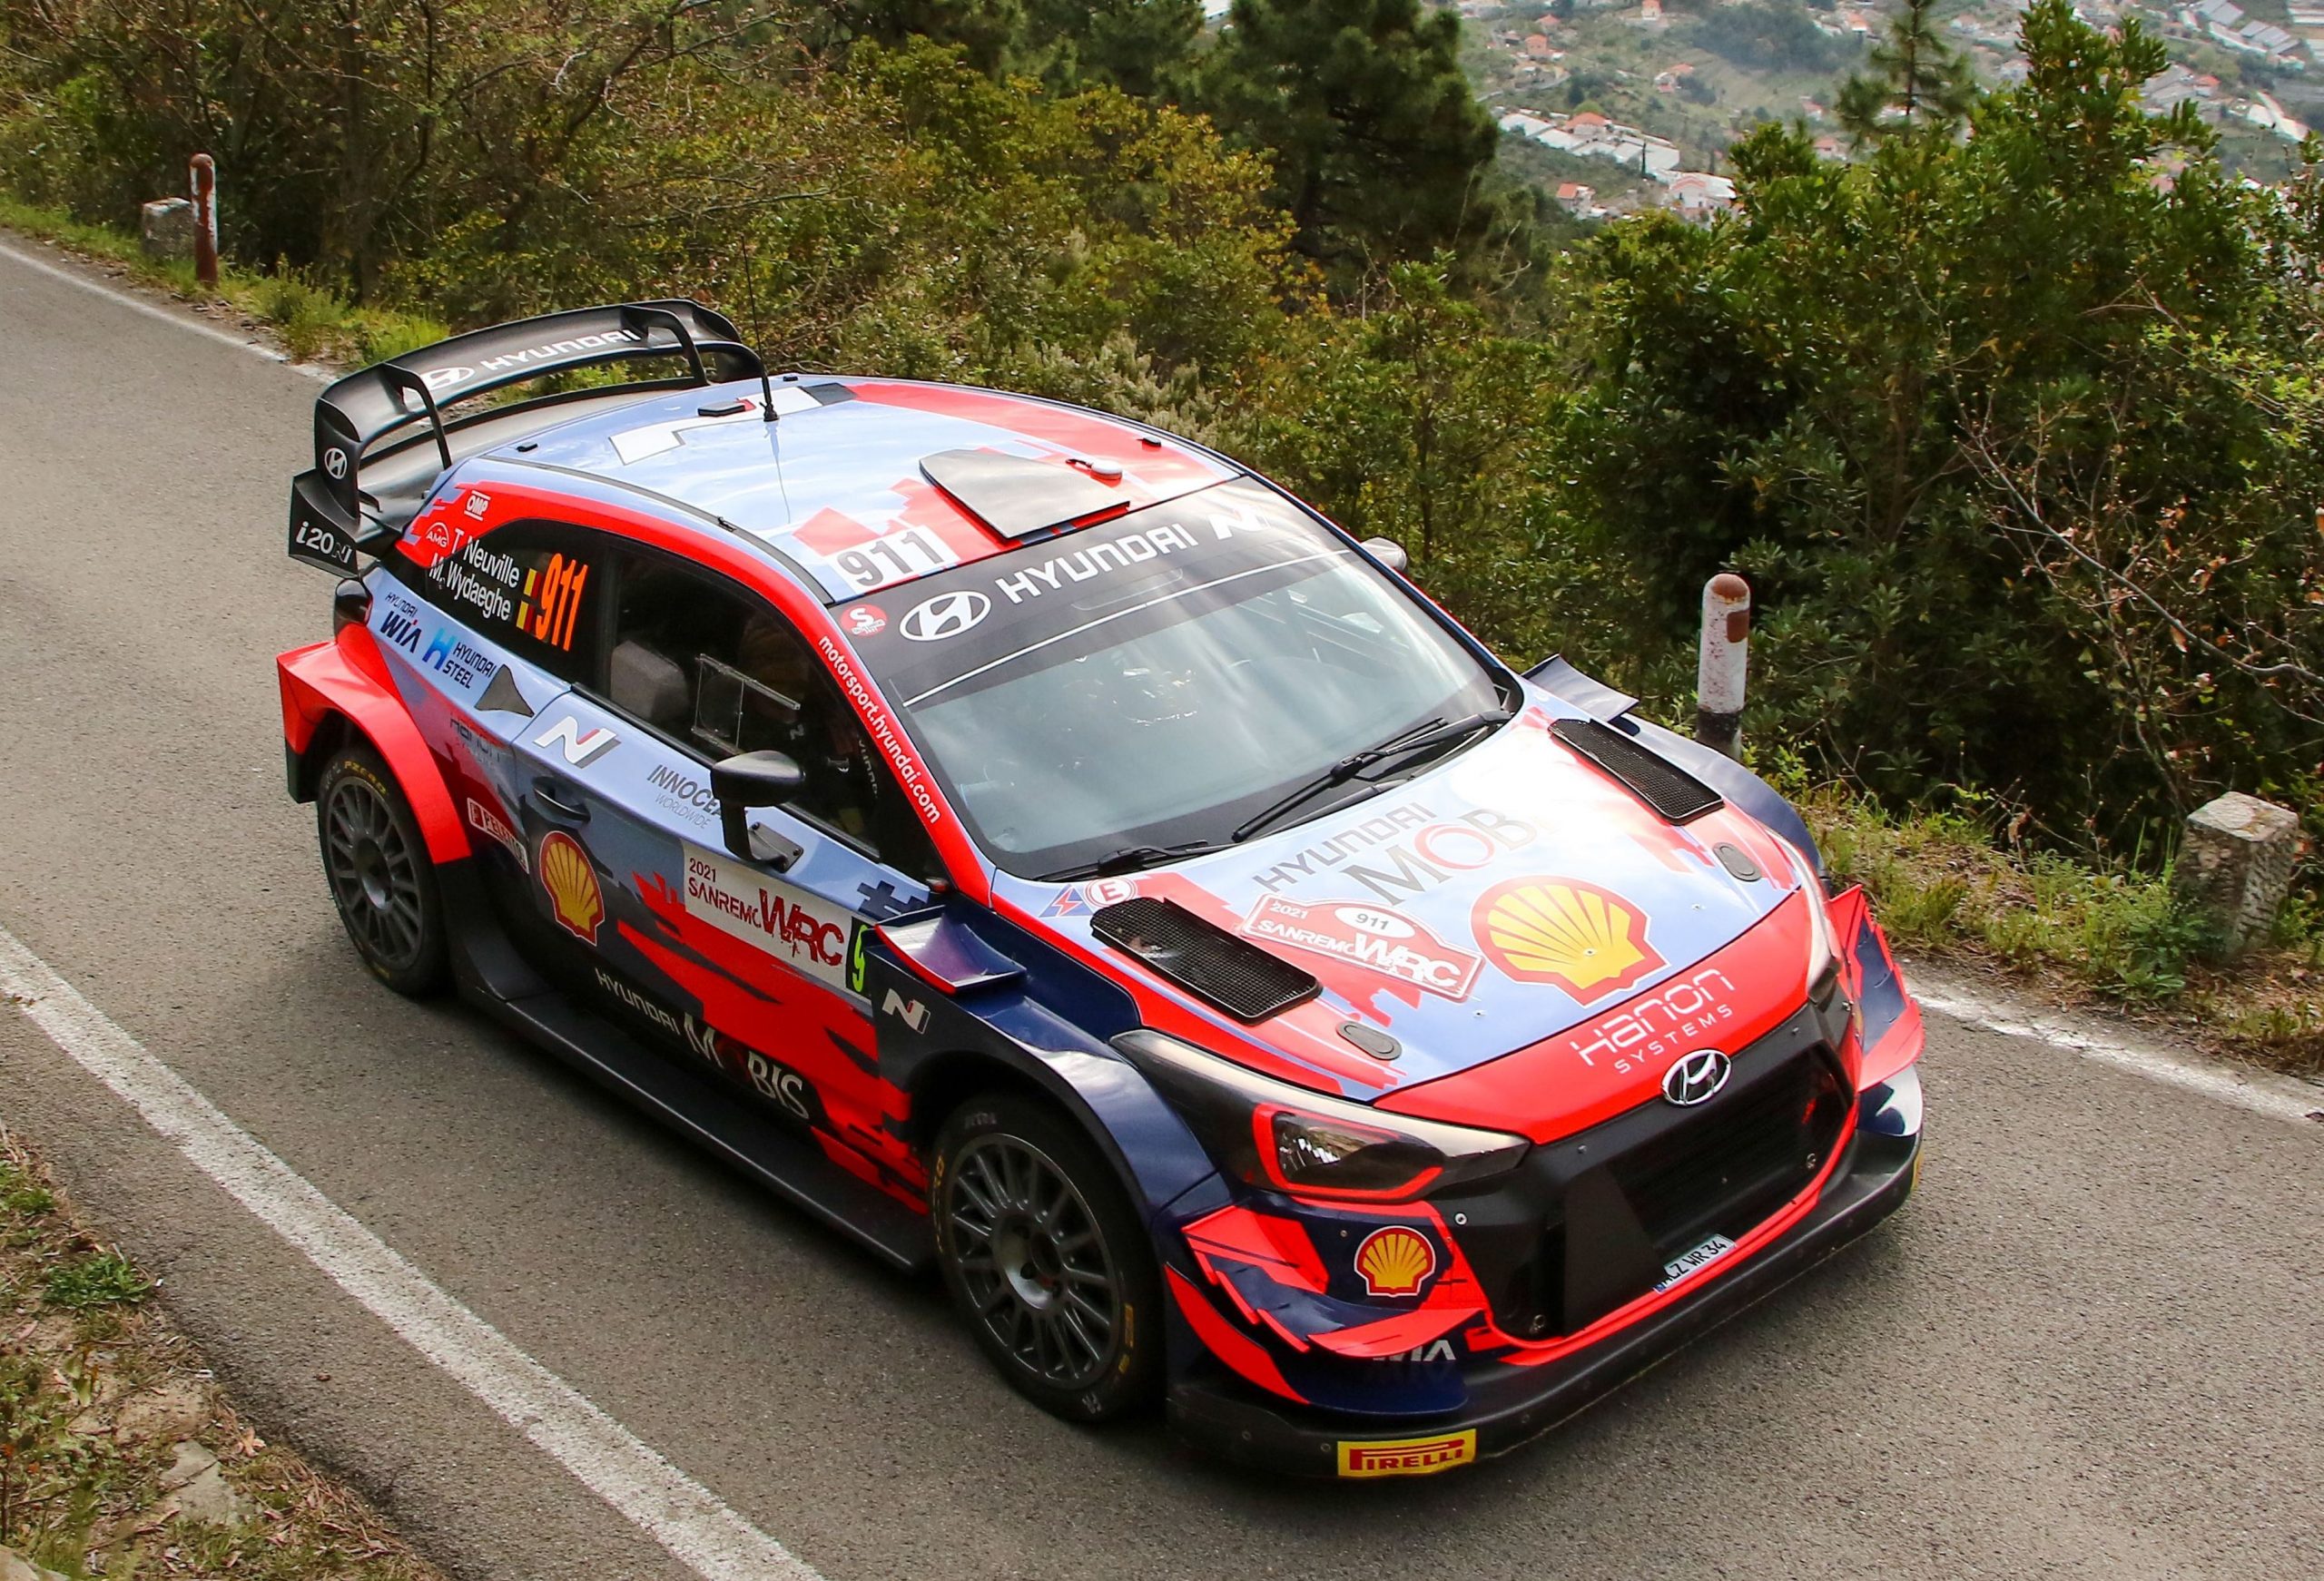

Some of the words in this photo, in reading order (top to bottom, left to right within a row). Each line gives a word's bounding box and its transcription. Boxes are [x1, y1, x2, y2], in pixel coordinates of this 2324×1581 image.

[481, 329, 641, 370] HYUNDAI
[466, 495, 488, 516] OMP
[463, 535, 520, 588] Neuville
[836, 528, 947, 586] 911
[995, 523, 1199, 604] HYUNDAI
[385, 592, 419, 618] HYUNDAI
[446, 561, 512, 621] Wydaeghe
[535, 553, 588, 652] 911
[379, 610, 422, 653] WIA
[442, 661, 474, 690] STEEL
[452, 643, 497, 679] HYUNDAI
[819, 636, 940, 823] motorsport.hyundai.com
[655, 793, 712, 830] WORLDWIDE
[689, 858, 716, 882] 2021
[1252, 801, 1437, 892] HYUNDAI
[1340, 808, 1538, 906] MOB
[759, 889, 844, 967] WRC
[1272, 900, 1307, 920] 2021
[1355, 913, 1389, 930] 911
[1354, 932, 1462, 987] WRC
[596, 967, 681, 1036] HYUNDAI
[1614, 1004, 1733, 1075] SYSTEMS
[1682, 1251, 1709, 1266] WR
[1701, 1240, 1728, 1255] 34
[1349, 1439, 1466, 1470] PIRELLI
